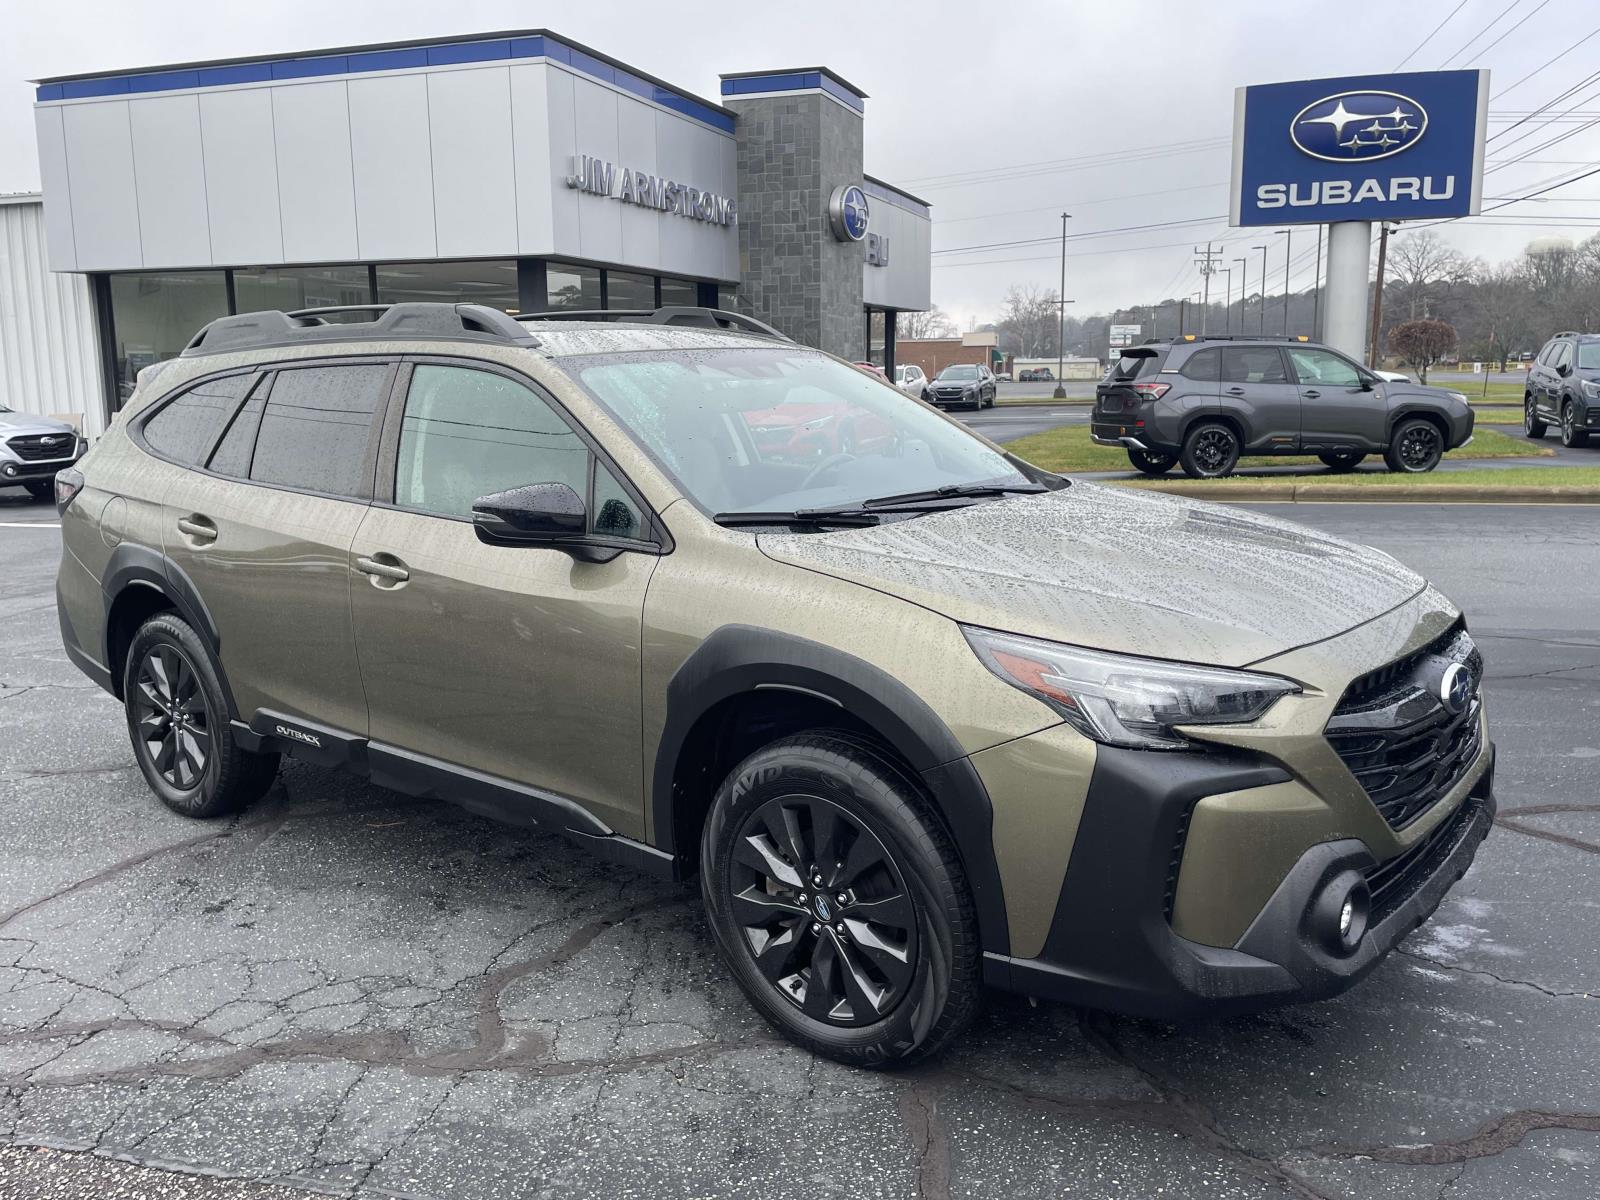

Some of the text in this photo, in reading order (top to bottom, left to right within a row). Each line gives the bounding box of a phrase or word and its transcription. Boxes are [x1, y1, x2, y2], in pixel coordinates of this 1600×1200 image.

[567, 154, 738, 225] JIM ARMSTRONG
[1256, 175, 1455, 209] SUBARU
[276, 725, 321, 747] OUTBACK
